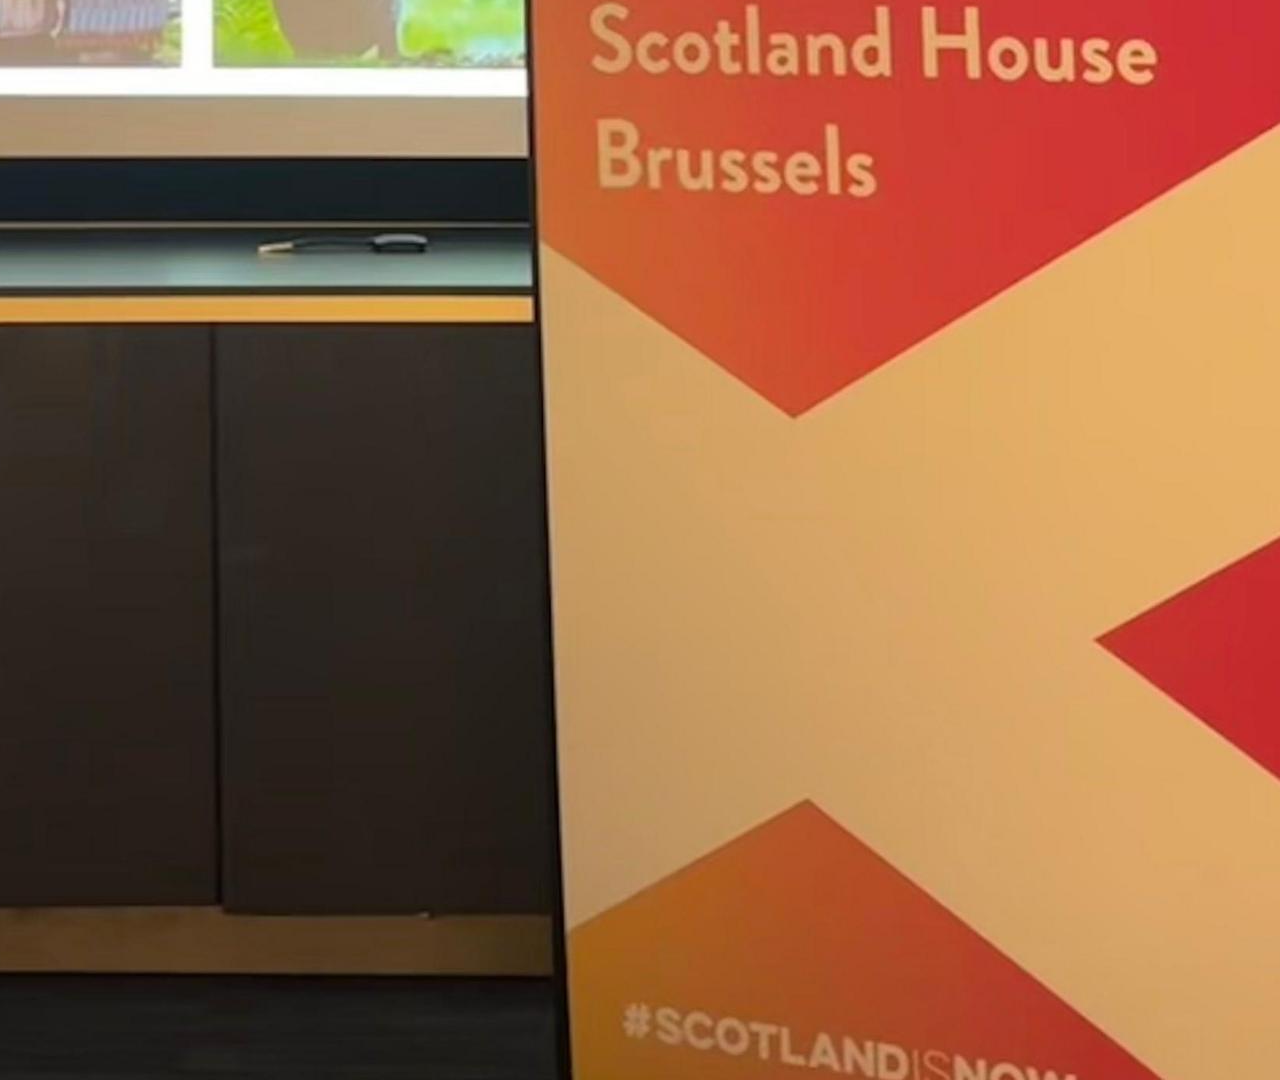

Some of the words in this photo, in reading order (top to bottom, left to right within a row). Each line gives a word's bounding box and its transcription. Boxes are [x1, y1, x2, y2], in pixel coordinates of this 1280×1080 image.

[590, 2, 893, 78] Scotland
[921, 5, 1158, 86] House
[597, 118, 877, 197] Brussels
